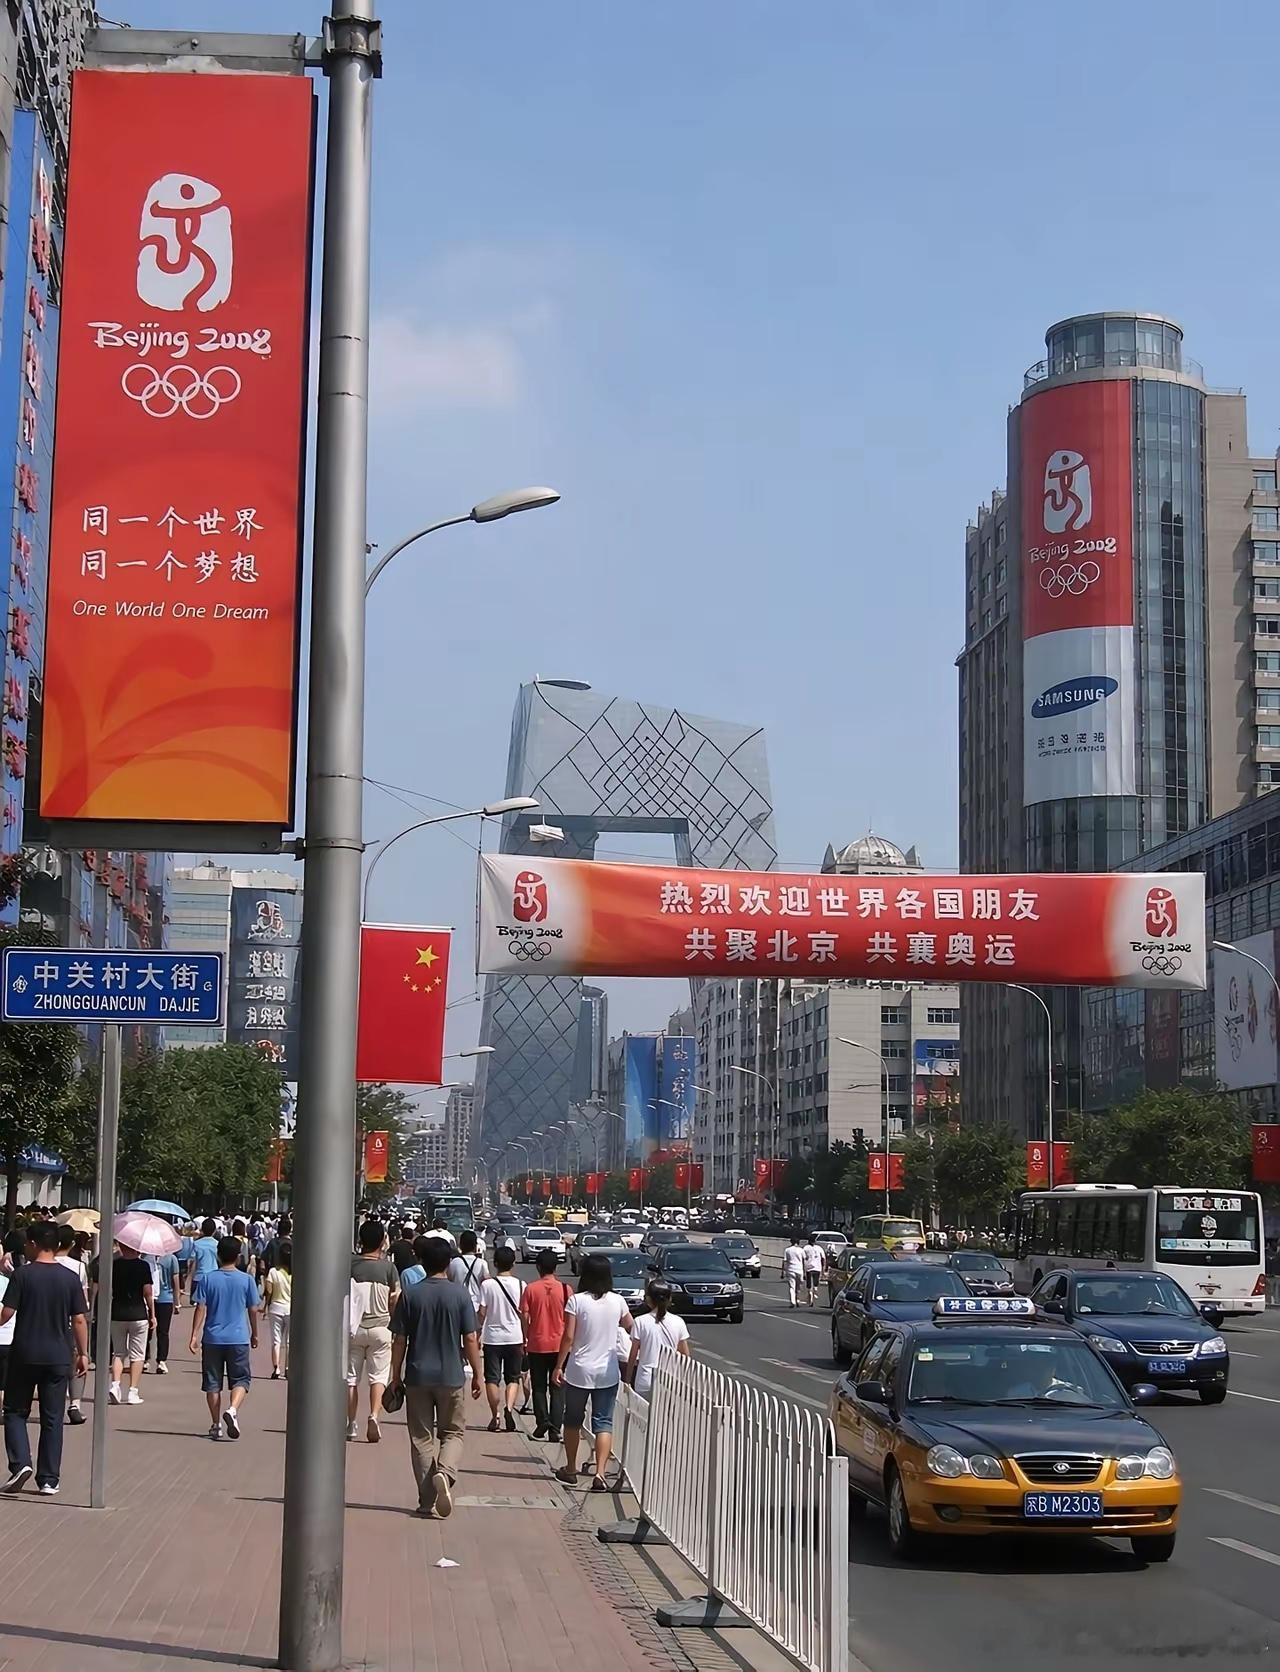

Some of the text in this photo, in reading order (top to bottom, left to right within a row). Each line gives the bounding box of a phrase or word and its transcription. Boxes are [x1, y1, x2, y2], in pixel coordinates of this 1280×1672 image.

[87, 321, 272, 359] Beijing 2008
[82, 505, 265, 541] 同一个世界
[80, 549, 260, 584] 同一个梦想
[1028, 541, 1069, 563] Beijing
[73, 600, 269, 620] One World One Dream
[1038, 688, 1105, 707] SAMSUNG
[660, 881, 1040, 921] 热烈欢迎世界各国朋友
[684, 927, 1016, 966] 共聚北京 共襄奥运
[33, 960, 200, 991] 中关村大街
[33, 994, 200, 1012] ZHONGGUANCUN DAJIE
